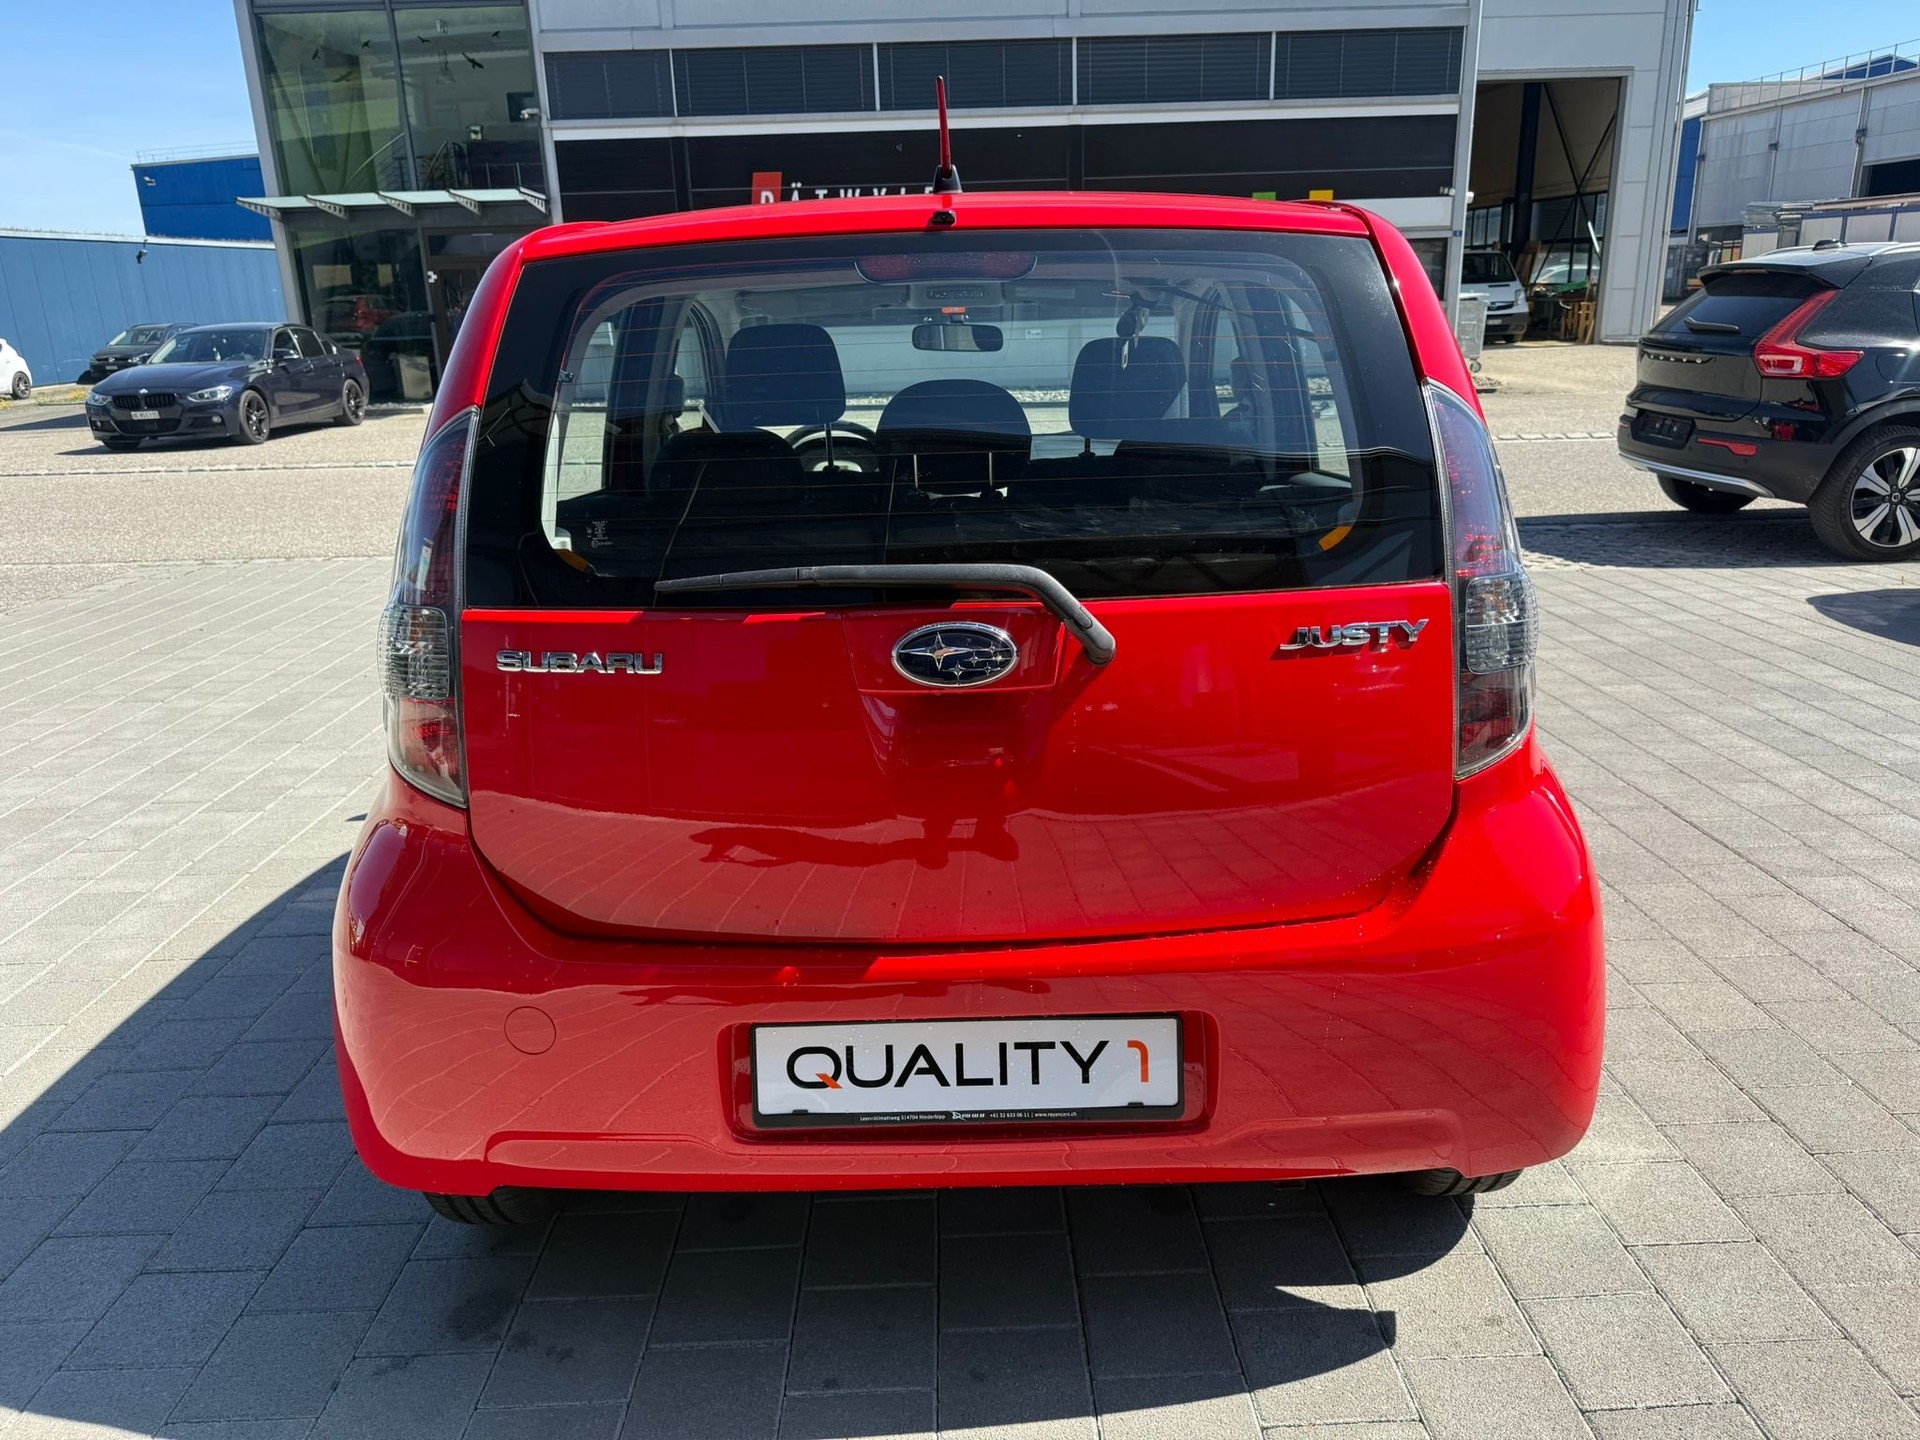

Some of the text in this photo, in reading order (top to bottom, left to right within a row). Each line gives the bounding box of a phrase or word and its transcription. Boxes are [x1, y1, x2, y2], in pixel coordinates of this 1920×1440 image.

[1279, 618, 1430, 651] JUSTY
[496, 650, 663, 674] SUBARU
[785, 1040, 1110, 1089] QUALITY
